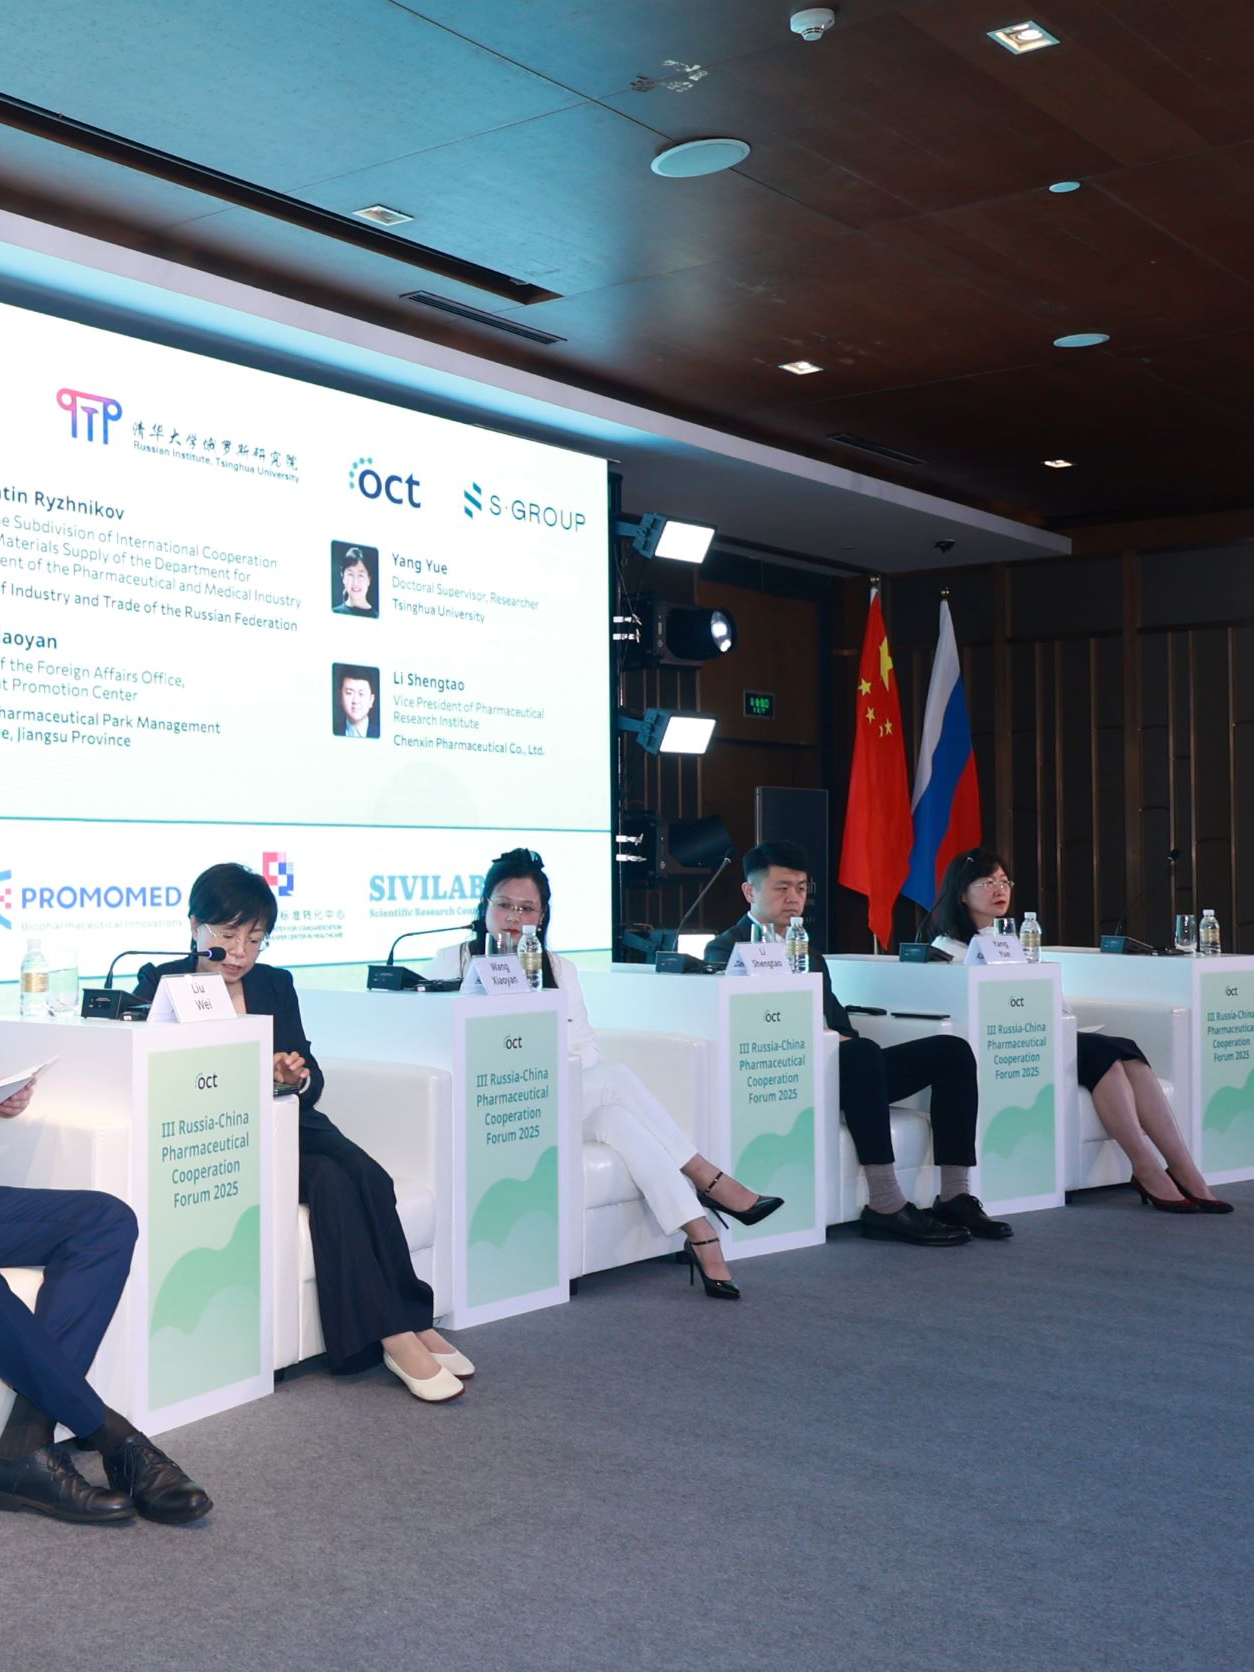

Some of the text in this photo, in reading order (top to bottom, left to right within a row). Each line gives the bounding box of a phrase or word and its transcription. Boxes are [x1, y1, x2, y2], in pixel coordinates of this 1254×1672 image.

[133, 439, 300, 484] Russian Institute, Tsinghua University
[358, 469, 421, 509] oct
[33, 489, 125, 521] Ryzhnikov
[12, 513, 95, 540] Subdivision
[97, 529, 113, 544] of
[115, 531, 199, 557] International
[201, 544, 277, 569] Cooperation
[61, 541, 109, 564] Supply
[111, 550, 128, 565] of
[129, 553, 152, 569] the
[153, 555, 231, 581] Department
[232, 567, 251, 583] for
[391, 552, 448, 576] Yang Yue
[26, 556, 43, 572] of
[45, 559, 70, 577] the
[72, 562, 176, 591] Pharmaceutical
[178, 581, 202, 595] and
[204, 582, 252, 601] Medical
[253, 589, 302, 610] Industry
[10, 582, 71, 606] Industry
[73, 593, 100, 608] and
[102, 594, 141, 613] Trade
[142, 600, 158, 614] of
[160, 602, 182, 618] the
[184, 604, 232, 623] Russian
[233, 611, 298, 632] Federation
[391, 597, 485, 624] Tsinghua University
[8, 657, 34, 674] the
[36, 659, 90, 681] Foreign
[92, 665, 139, 684] Affairs
[140, 669, 185, 689] Office,
[392, 670, 465, 694] Li Shengtao
[11, 676, 89, 697] Promotion
[91, 684, 139, 702] Center
[102, 712, 134, 729] Park
[136, 715, 221, 735] Management
[16, 726, 68, 746] Jiangsu
[70, 729, 131, 748] Province
[392, 733, 545, 756] Chenxin Pharmaceutical Co., Ltd.
[21, 885, 183, 910] PROMOMED
[369, 874, 485, 902] SIVILAB
[191, 982, 205, 995] Liu
[195, 998, 213, 1011] Wei
[476, 1066, 549, 1088] III Russia-China
[476, 1085, 549, 1107] Pharmaceutical
[484, 1107, 542, 1127] Cooperation
